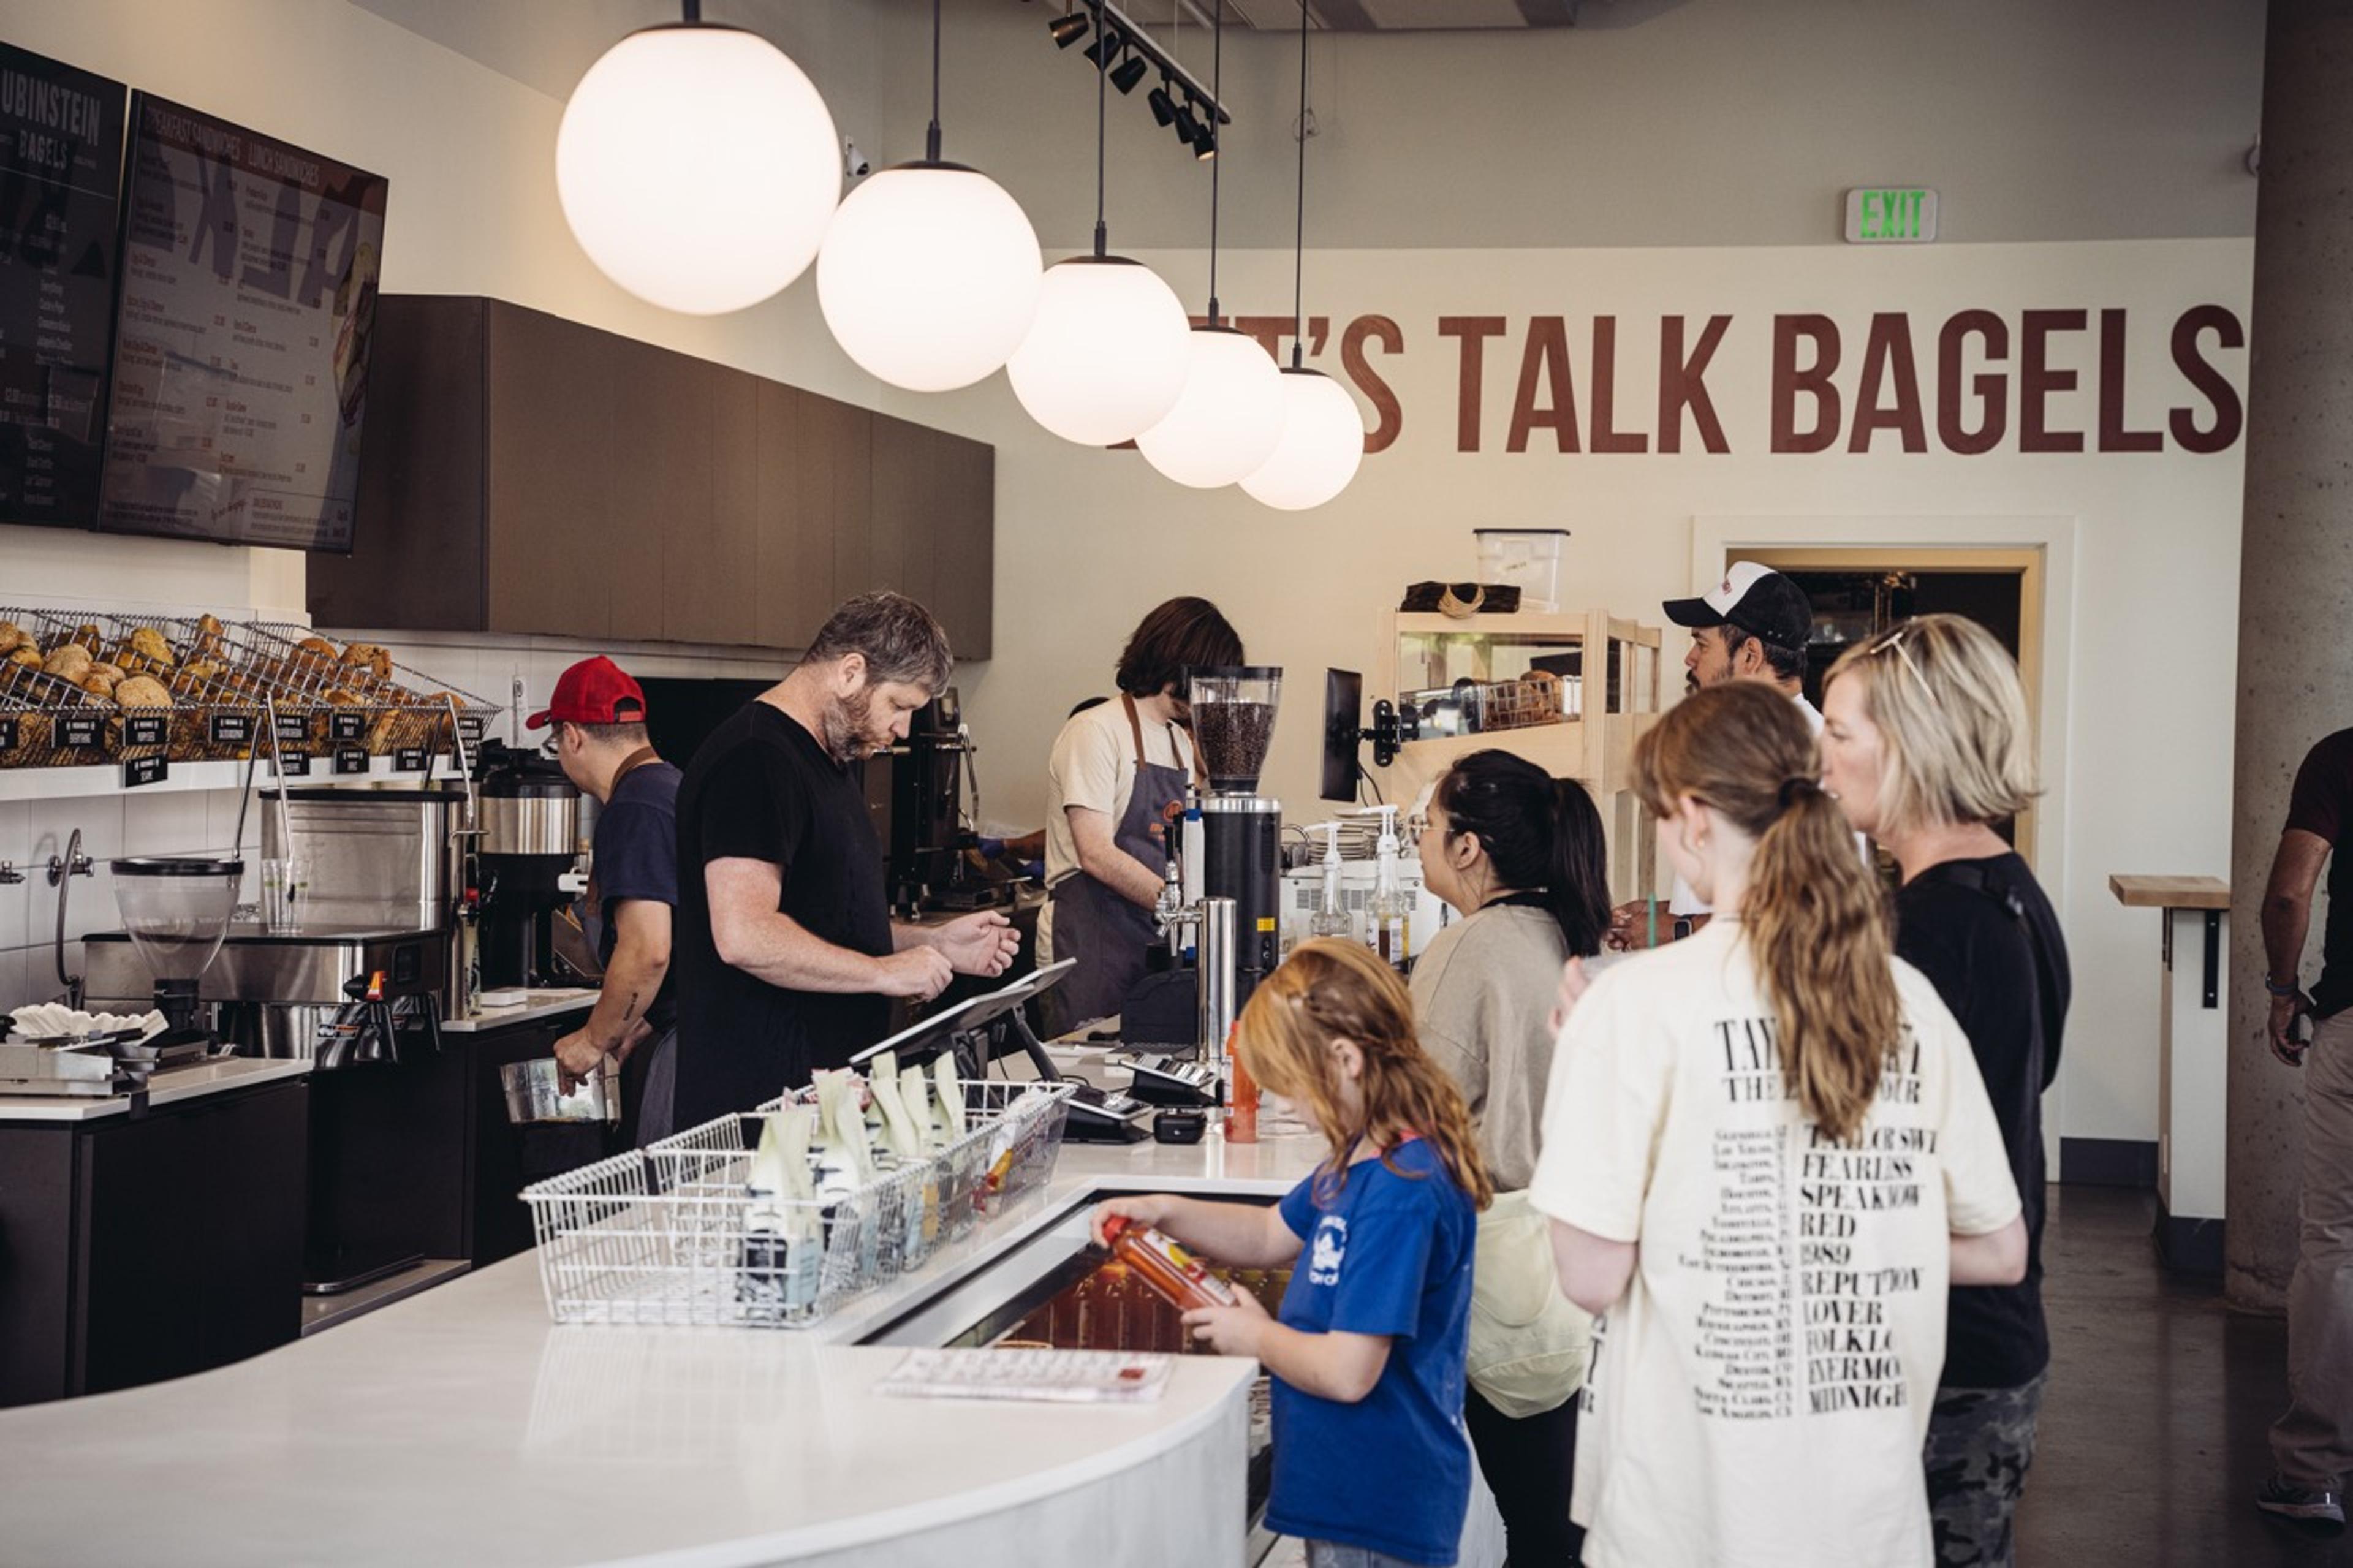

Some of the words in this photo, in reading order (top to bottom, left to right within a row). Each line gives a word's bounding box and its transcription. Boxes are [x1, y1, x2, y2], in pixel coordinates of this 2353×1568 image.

[0, 69, 102, 147] UBINSTEIN
[18, 129, 68, 171] BAGELS
[1860, 191, 1925, 239] EXIT
[1439, 313, 1732, 454] TALK
[1770, 303, 2245, 455] BAGELS
[1715, 1017, 1777, 1071] TAY
[1721, 1075, 1778, 1102] THE
[1800, 1212, 1857, 1238] RED
[1802, 1300, 1882, 1325] LOVER
